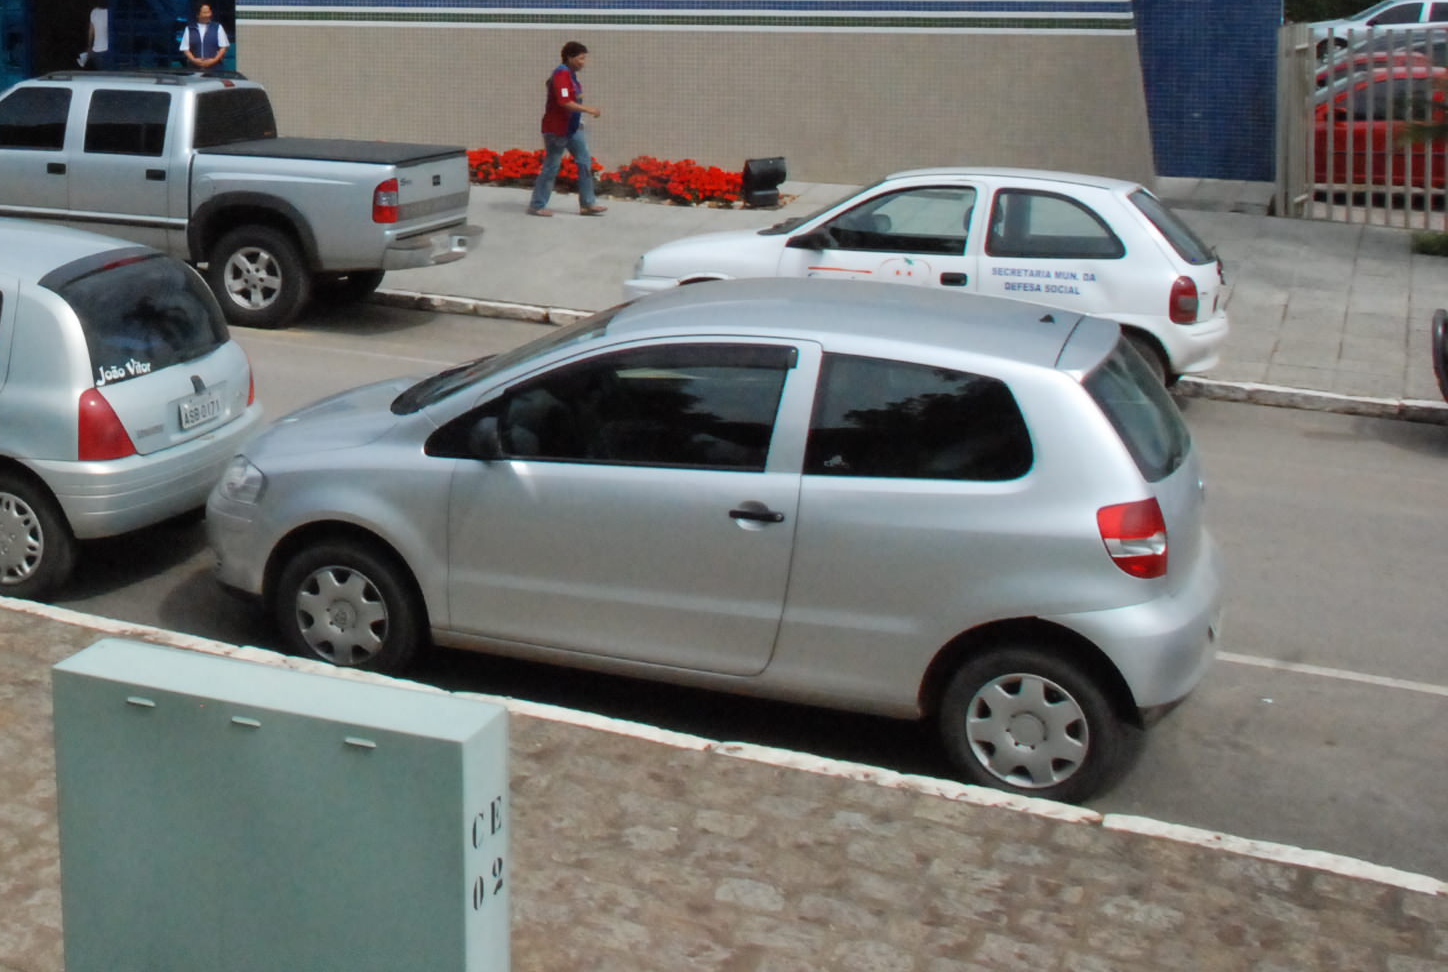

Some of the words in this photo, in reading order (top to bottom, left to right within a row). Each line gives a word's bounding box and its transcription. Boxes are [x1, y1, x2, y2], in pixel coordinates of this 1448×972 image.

[991, 267, 1052, 278] SECRETARIA
[1083, 272, 1097, 282] DA
[1004, 281, 1041, 293] DEFESA
[1044, 283, 1080, 295] SOCIAL
[95, 366, 126, 386] João
[125, 358, 152, 375] Vitor
[472, 795, 502, 850] CE
